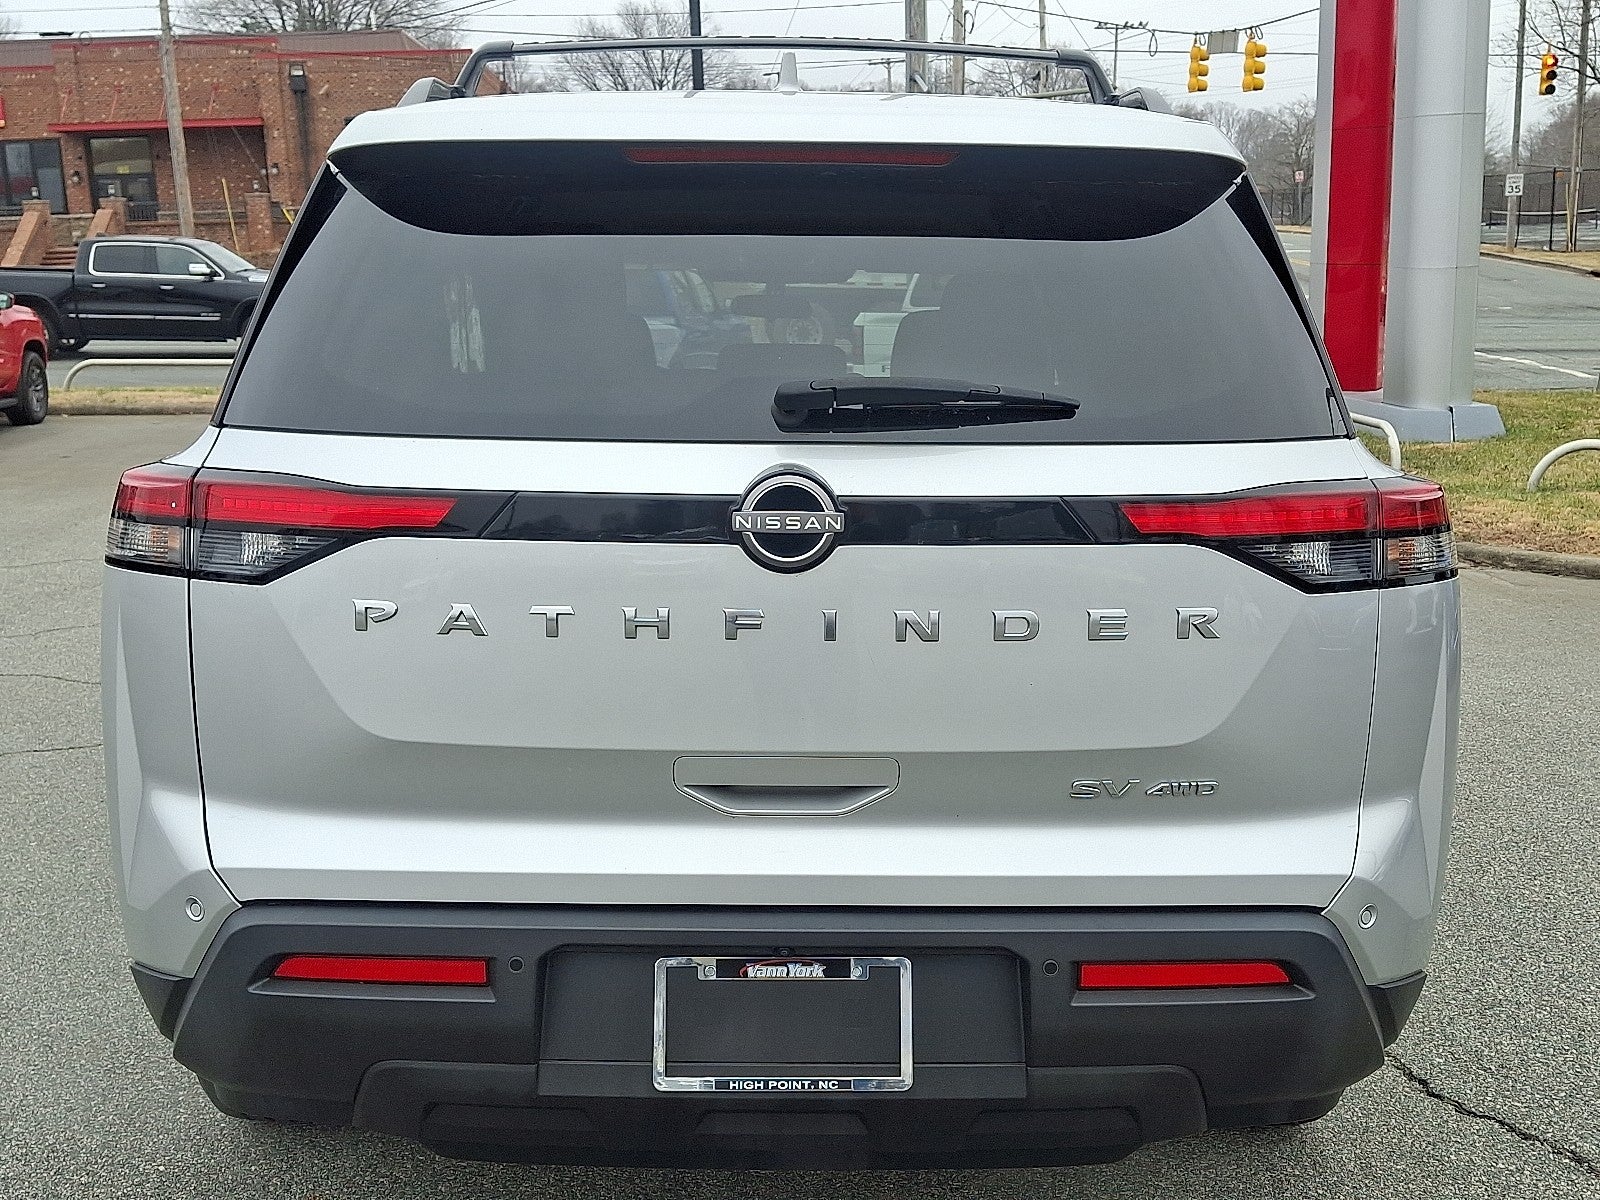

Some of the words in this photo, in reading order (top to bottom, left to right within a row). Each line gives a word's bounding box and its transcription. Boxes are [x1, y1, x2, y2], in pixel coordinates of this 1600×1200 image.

[1507, 185, 1521, 194] 35
[735, 515, 841, 530] NISSAN
[352, 598, 1221, 643] PATHFINDER
[1069, 779, 1140, 798] SV
[1145, 780, 1219, 797] 4WD
[729, 1080, 764, 1090] HIGH
[768, 1080, 815, 1090] POINT,
[818, 1080, 839, 1090] NC
